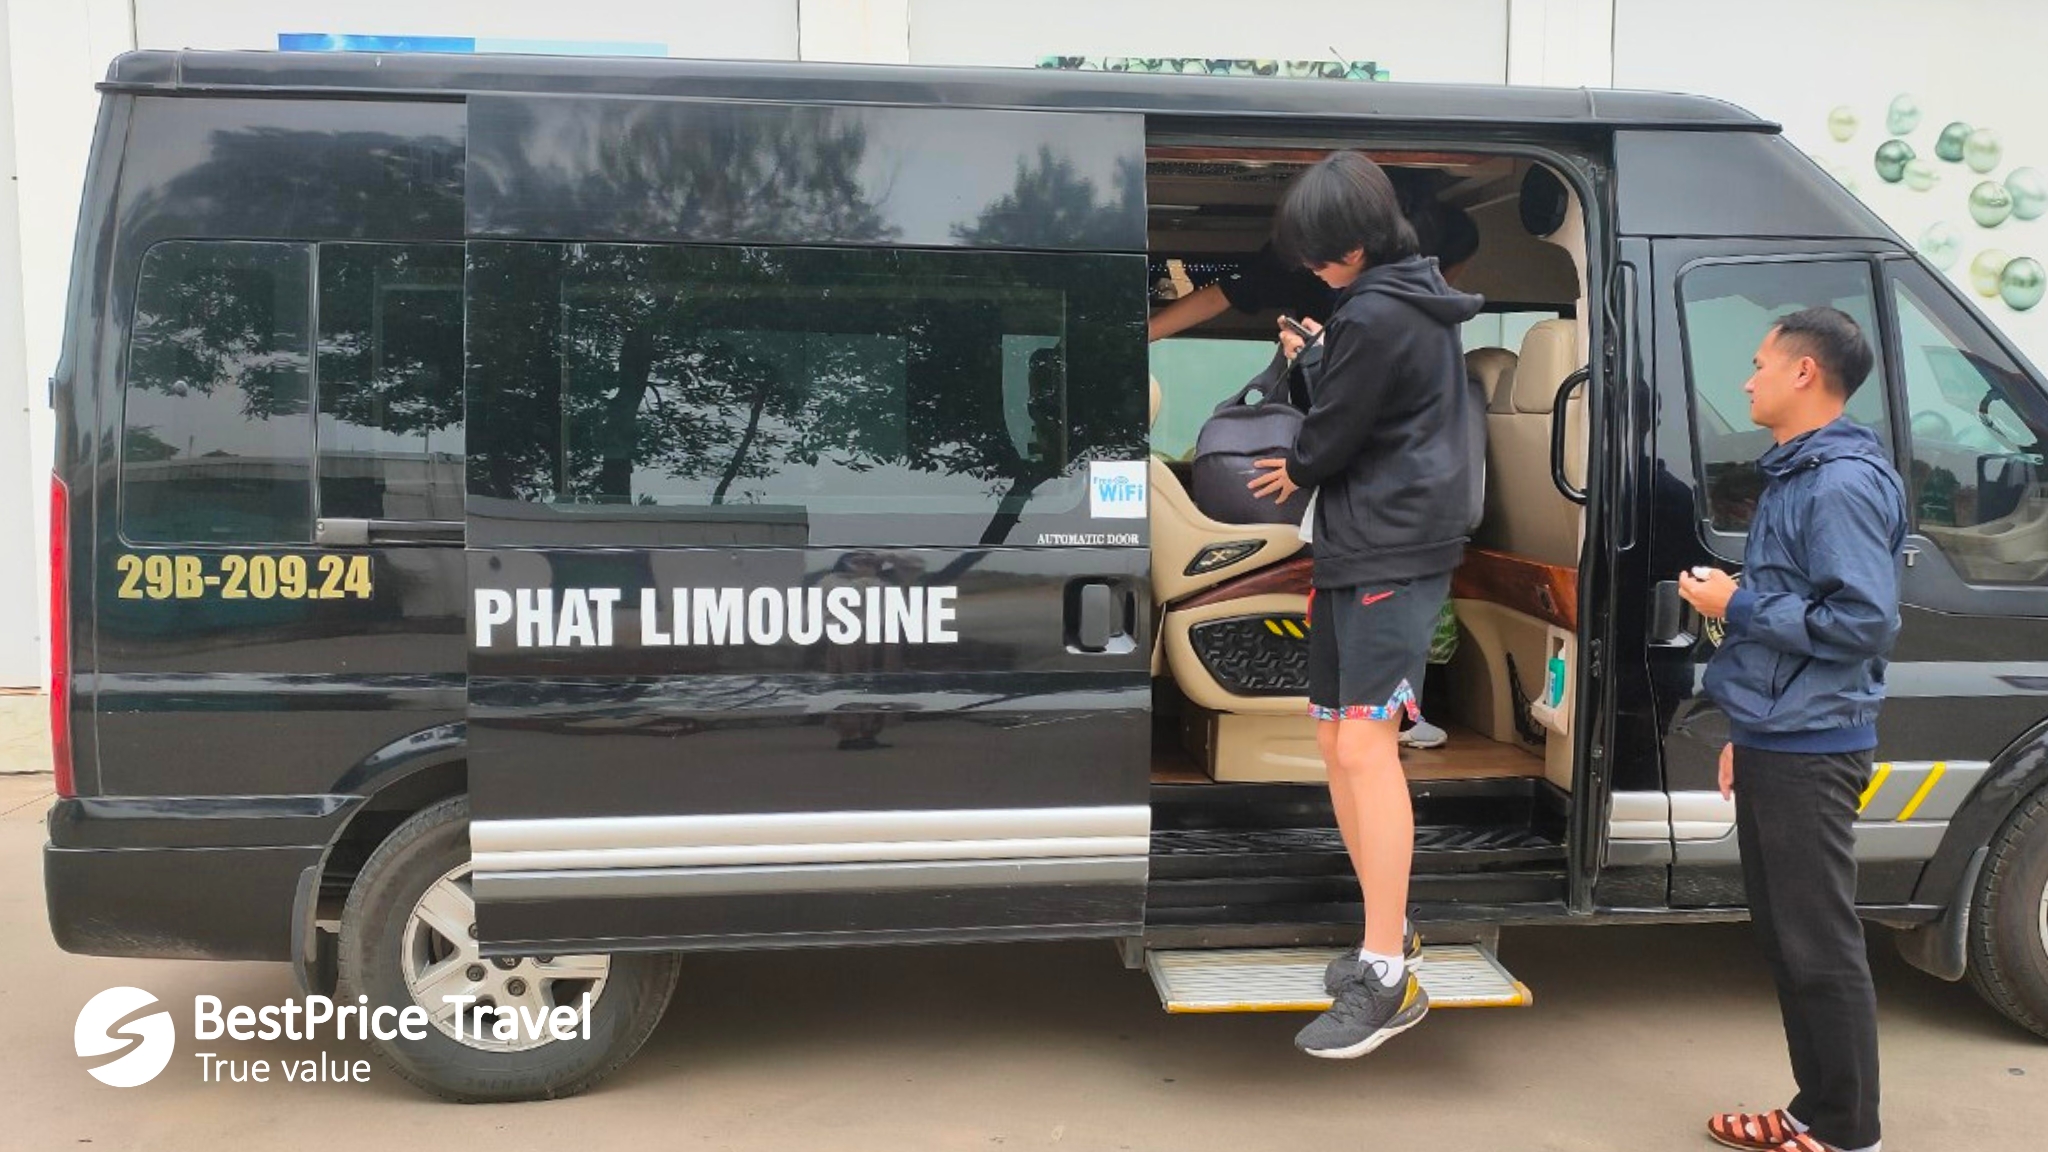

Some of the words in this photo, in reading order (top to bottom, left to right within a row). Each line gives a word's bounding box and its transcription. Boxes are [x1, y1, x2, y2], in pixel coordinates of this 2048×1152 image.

[1099, 483, 1143, 502] WiFi
[1037, 533, 1105, 545] AUTOMATIC
[1106, 533, 1139, 545] DOOR
[117, 554, 372, 599] 29B-209.24
[474, 588, 621, 648] PHAT
[640, 586, 959, 646] LIMOUSINE
